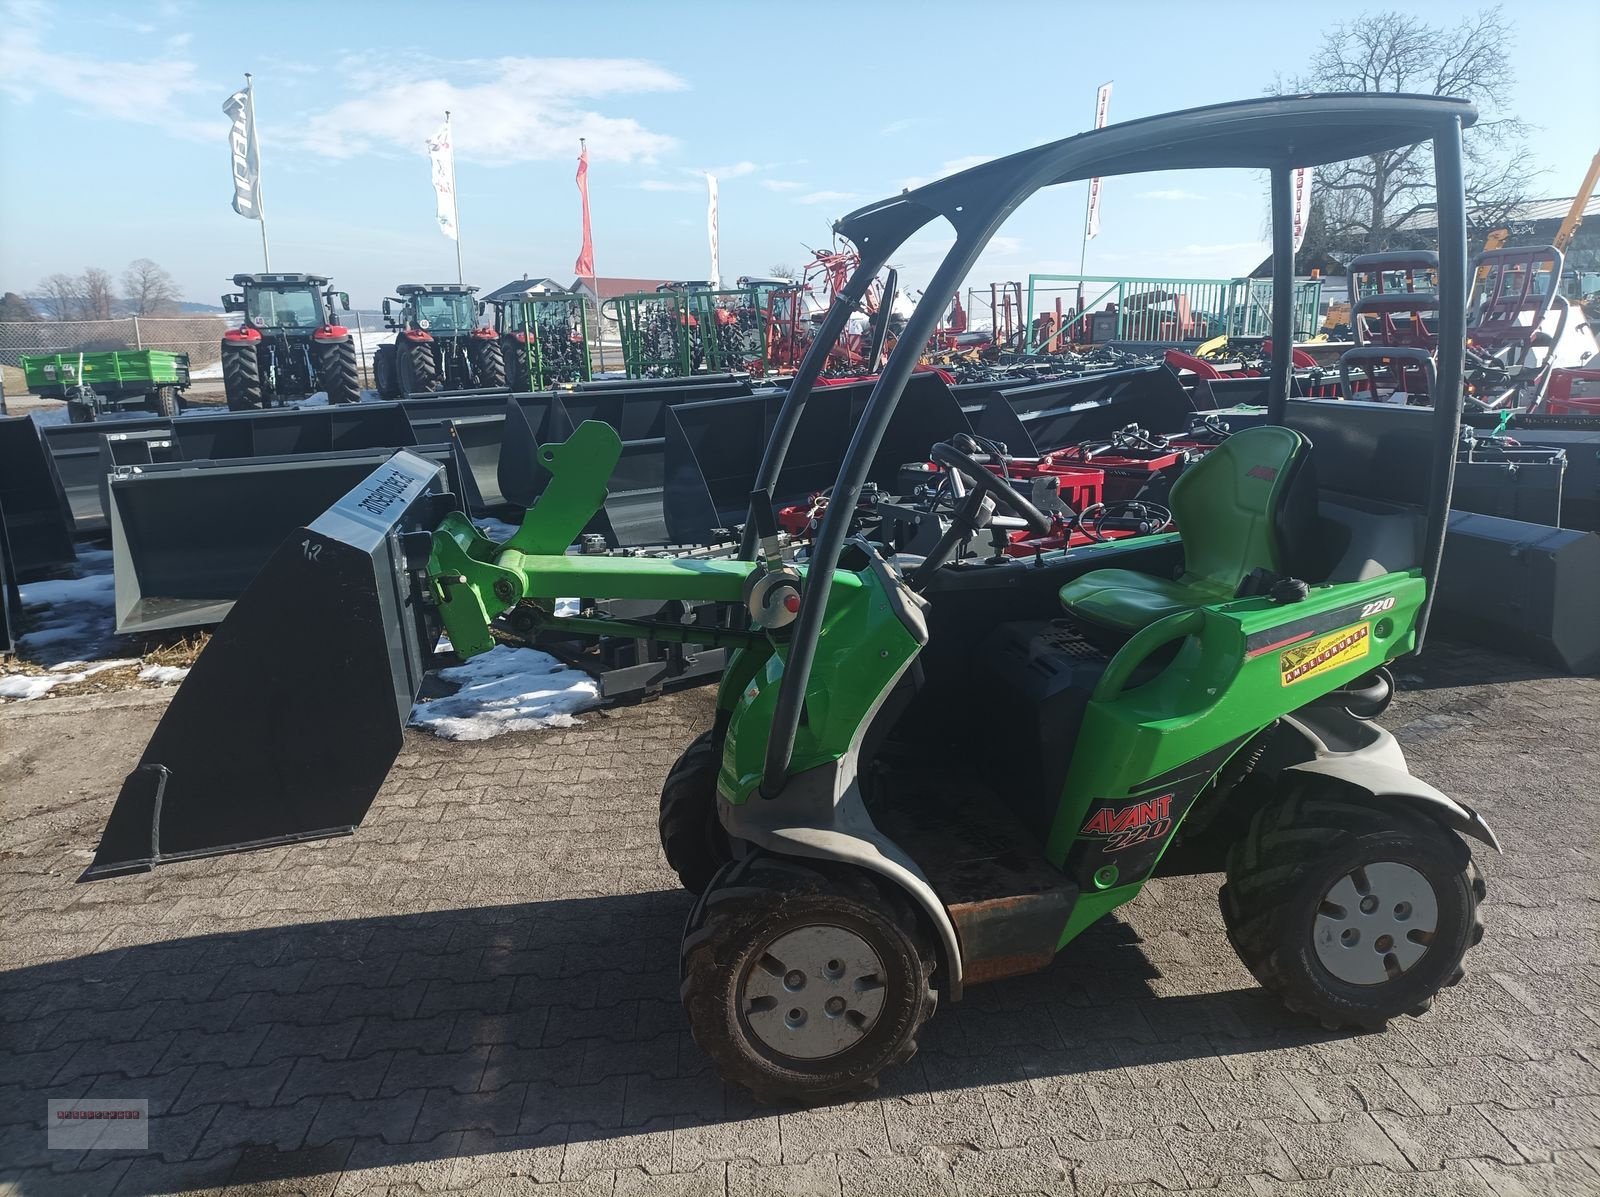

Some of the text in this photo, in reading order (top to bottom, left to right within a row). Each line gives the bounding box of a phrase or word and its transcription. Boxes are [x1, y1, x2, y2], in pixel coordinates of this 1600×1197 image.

[1360, 597, 1396, 619] 220
[1285, 626, 1368, 683] AMSELGRUBER
[1080, 793, 1173, 835] AVANT
[1102, 818, 1173, 853] 220
